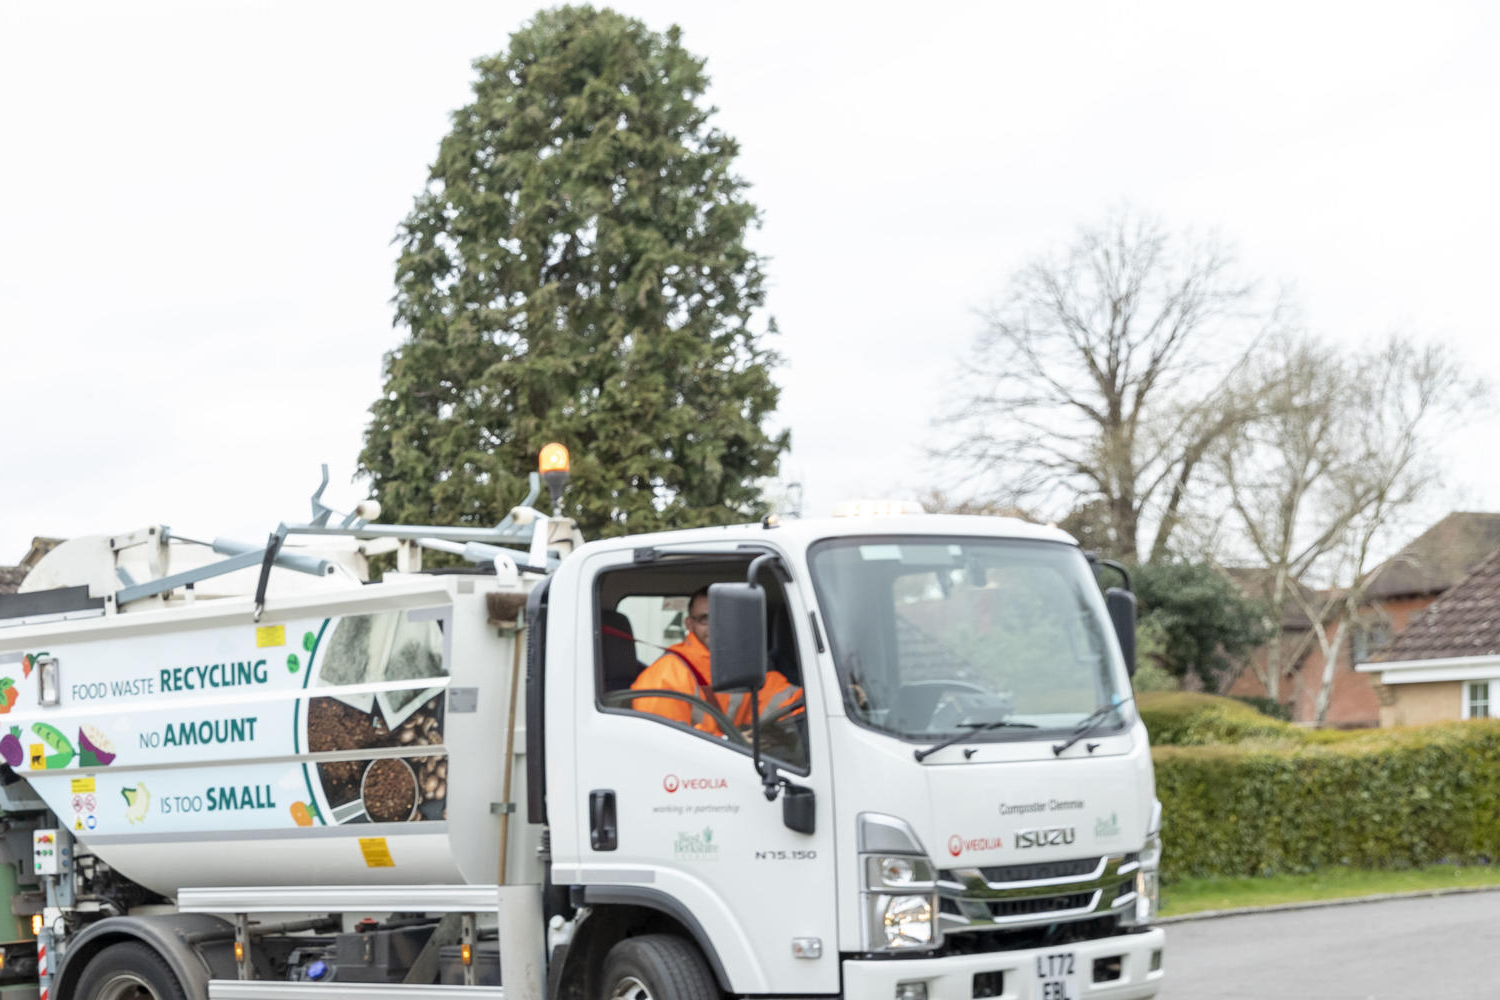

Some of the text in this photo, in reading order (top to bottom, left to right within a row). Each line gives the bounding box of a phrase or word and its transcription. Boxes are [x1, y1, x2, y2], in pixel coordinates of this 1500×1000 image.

[72, 659, 268, 700] FOOD WASTE RECYCLING
[139, 717, 257, 749] NO AMOUNT
[681, 778, 728, 790] VEOLIA
[160, 785, 276, 814] IS TOO SMALL
[963, 837, 1003, 851] VEOLIA
[1014, 827, 1076, 849] ISUZU
[1037, 953, 1076, 978] LT72
